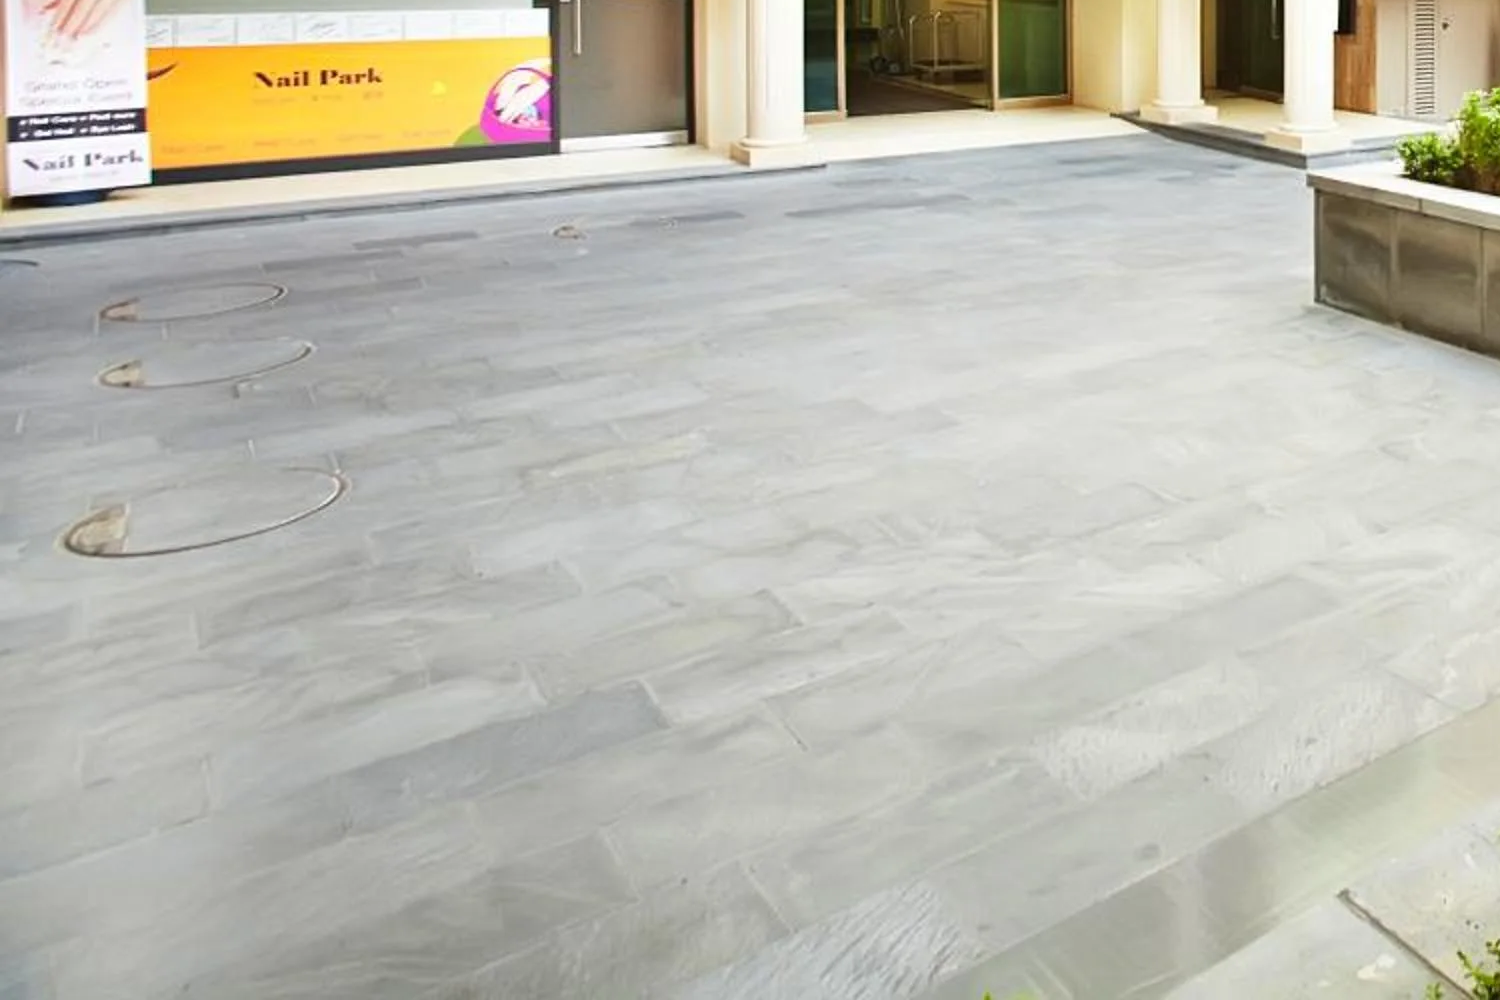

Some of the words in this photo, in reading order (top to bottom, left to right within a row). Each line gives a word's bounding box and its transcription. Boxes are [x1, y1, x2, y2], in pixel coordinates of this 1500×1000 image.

[254, 71, 310, 88] Nail
[320, 68, 383, 85] Park
[21, 154, 75, 171] Nail
[84, 149, 144, 167] Park
